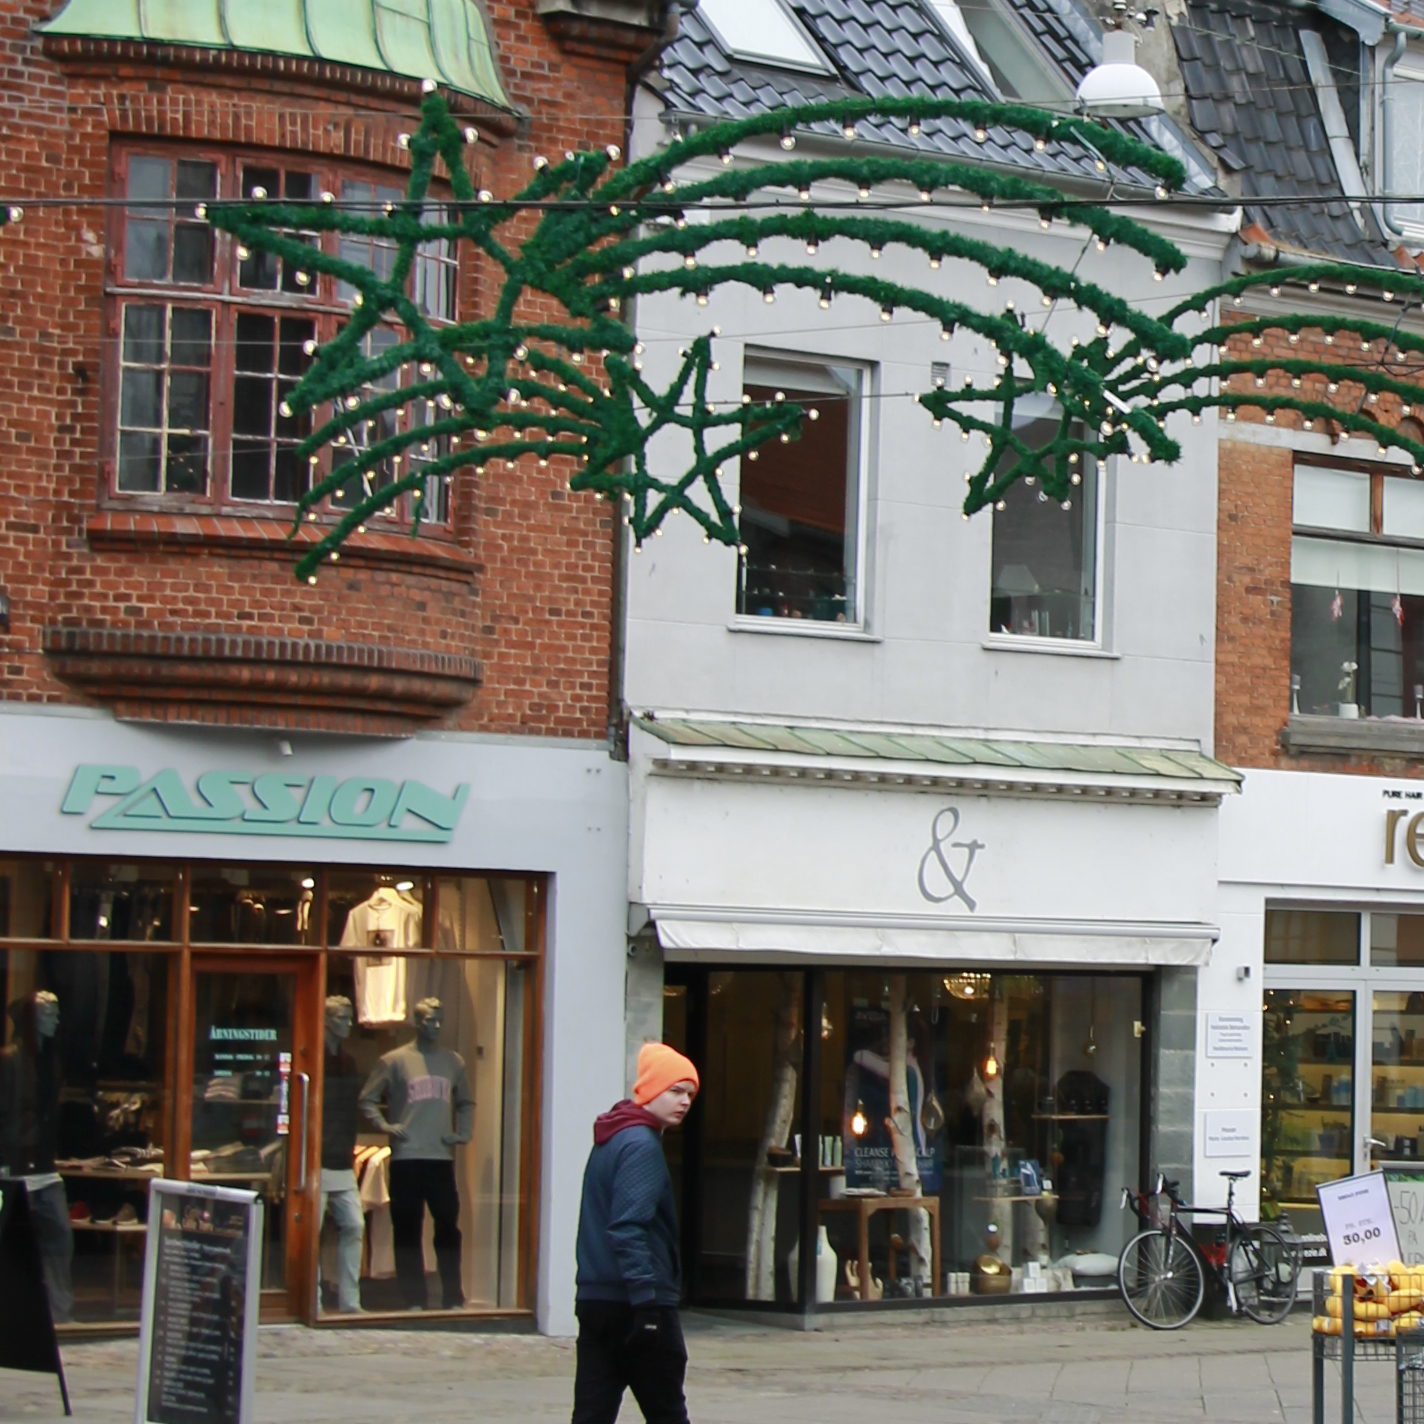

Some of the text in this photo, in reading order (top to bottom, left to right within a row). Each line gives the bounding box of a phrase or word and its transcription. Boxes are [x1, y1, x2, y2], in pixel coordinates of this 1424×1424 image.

[61, 764, 471, 844] PASSION
[1382, 789, 1401, 799] PURE
[1404, 791, 1422, 800] HAIR
[919, 806, 986, 913] &
[1343, 1226, 1381, 1246] 30,00
